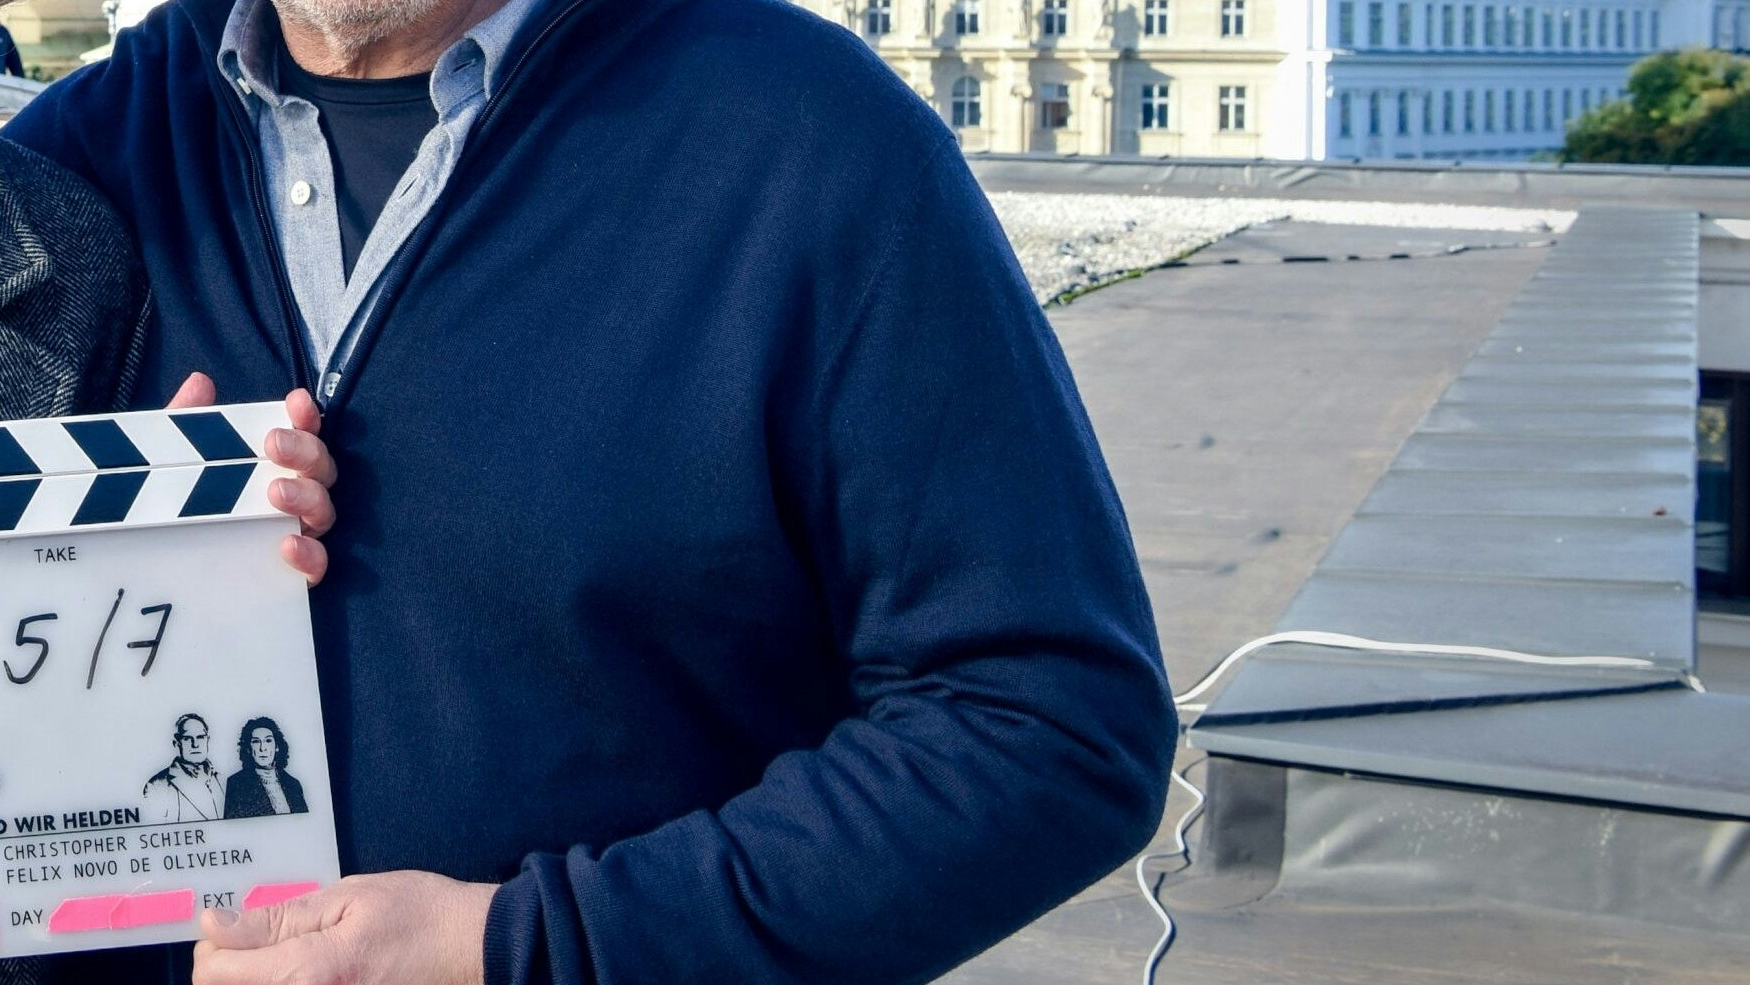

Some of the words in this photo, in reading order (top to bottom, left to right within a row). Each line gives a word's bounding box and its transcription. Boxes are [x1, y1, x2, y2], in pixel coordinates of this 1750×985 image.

[34, 546, 76, 564] TAKE
[14, 814, 57, 833] WIR
[63, 807, 141, 829] HELDEN
[3, 836, 127, 861] CHRISTOPHER
[139, 829, 206, 850] SCHIER
[6, 866, 62, 884] FELIX
[74, 860, 118, 878] NOVO
[131, 857, 151, 873] DE
[163, 848, 253, 870] OLIVEIRA
[204, 892, 235, 909] EXT
[11, 909, 44, 926] DAY
